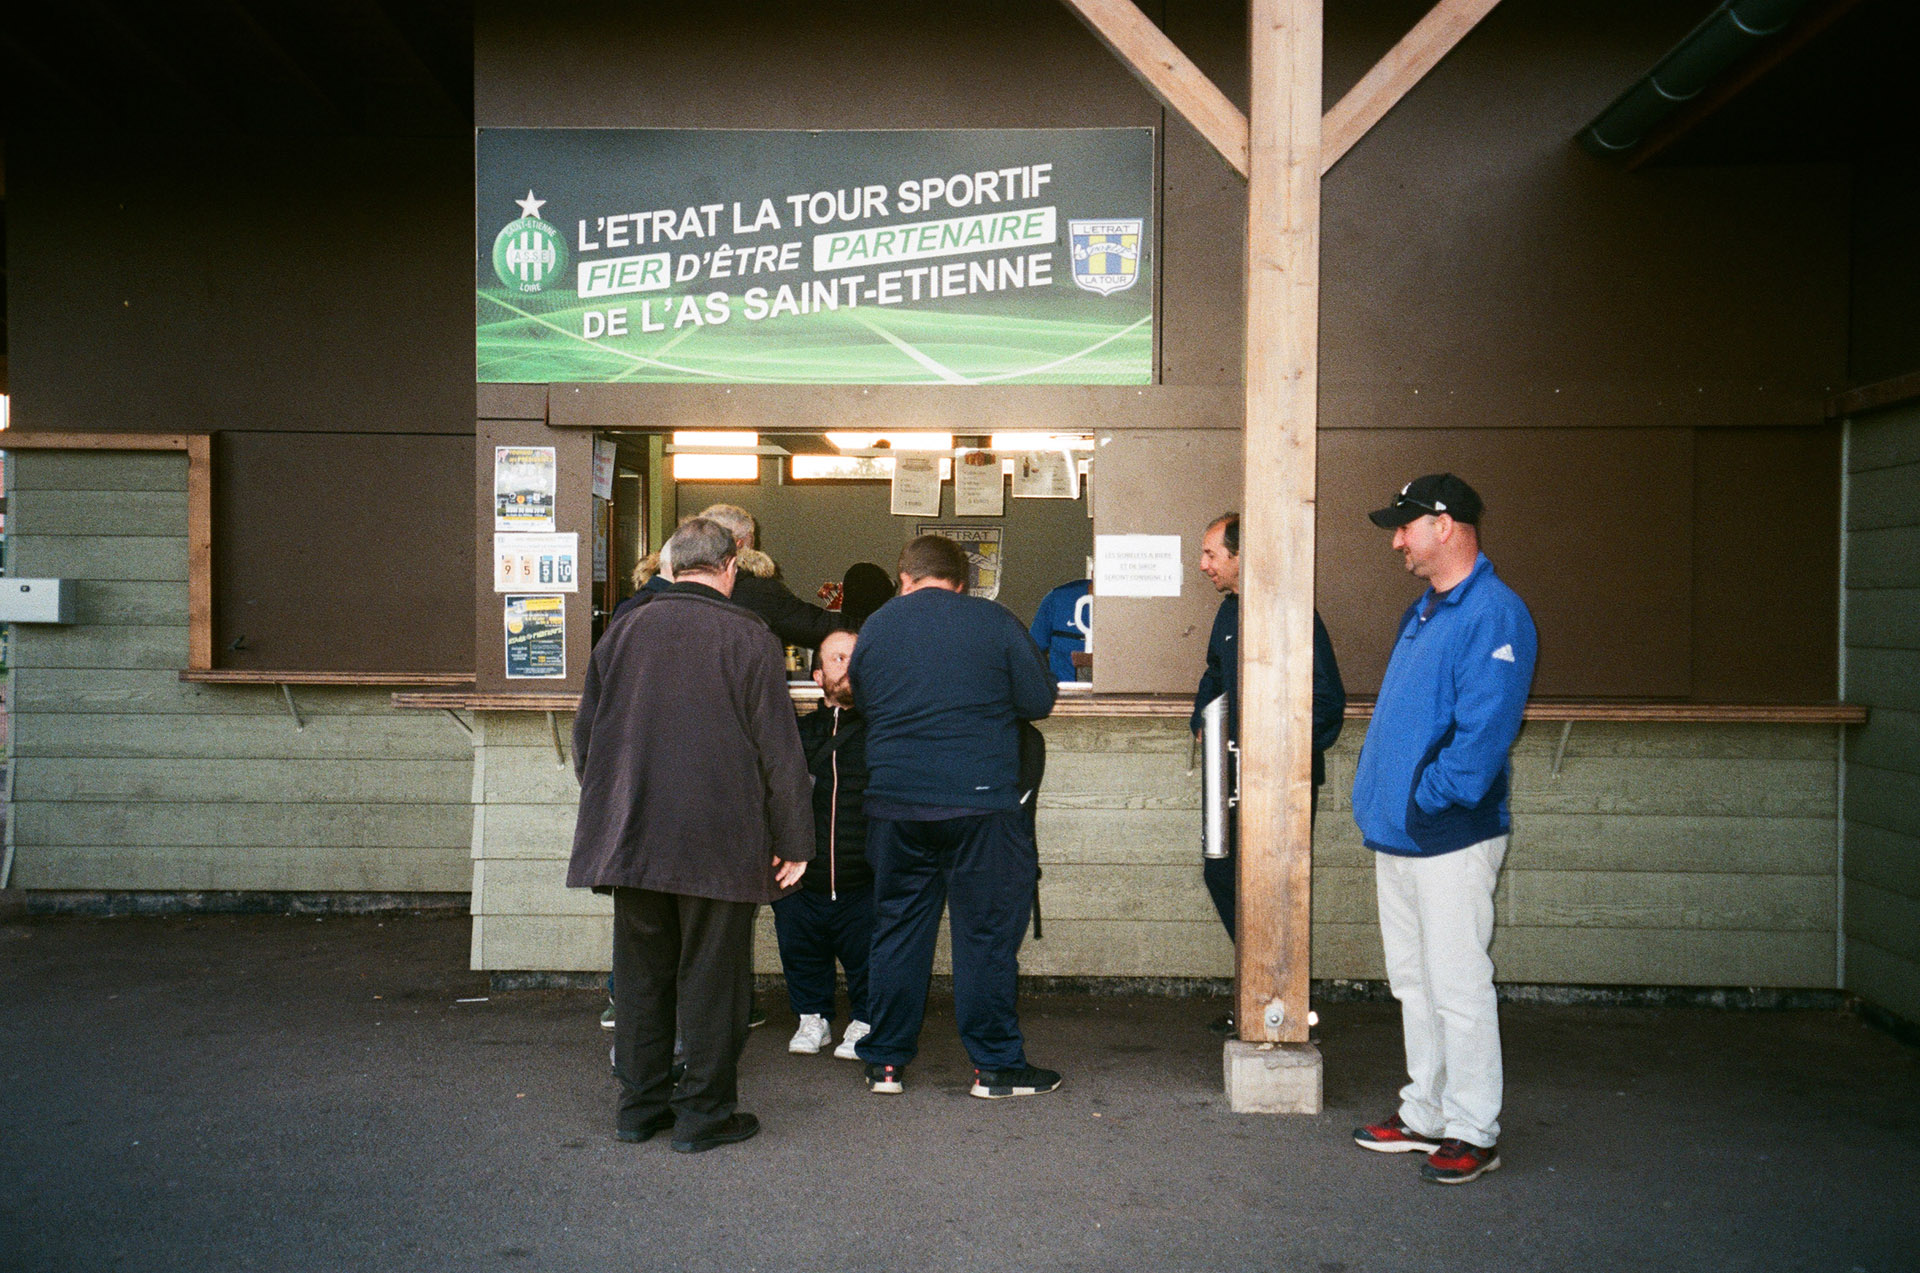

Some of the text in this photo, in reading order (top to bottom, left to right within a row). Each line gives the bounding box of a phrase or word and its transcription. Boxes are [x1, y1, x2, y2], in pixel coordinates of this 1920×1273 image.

[578, 163, 1053, 251] L'ETRAT LA TOUR SPORTIF
[514, 250, 548, 262] ASSE
[586, 211, 1045, 291] FIER D'ÊTRE PARTENAIRE
[519, 282, 542, 293] LOIRE
[583, 252, 1052, 339] DE L'AS SAINT-ETIENNE
[504, 565, 571, 576] 9 5 5 10
